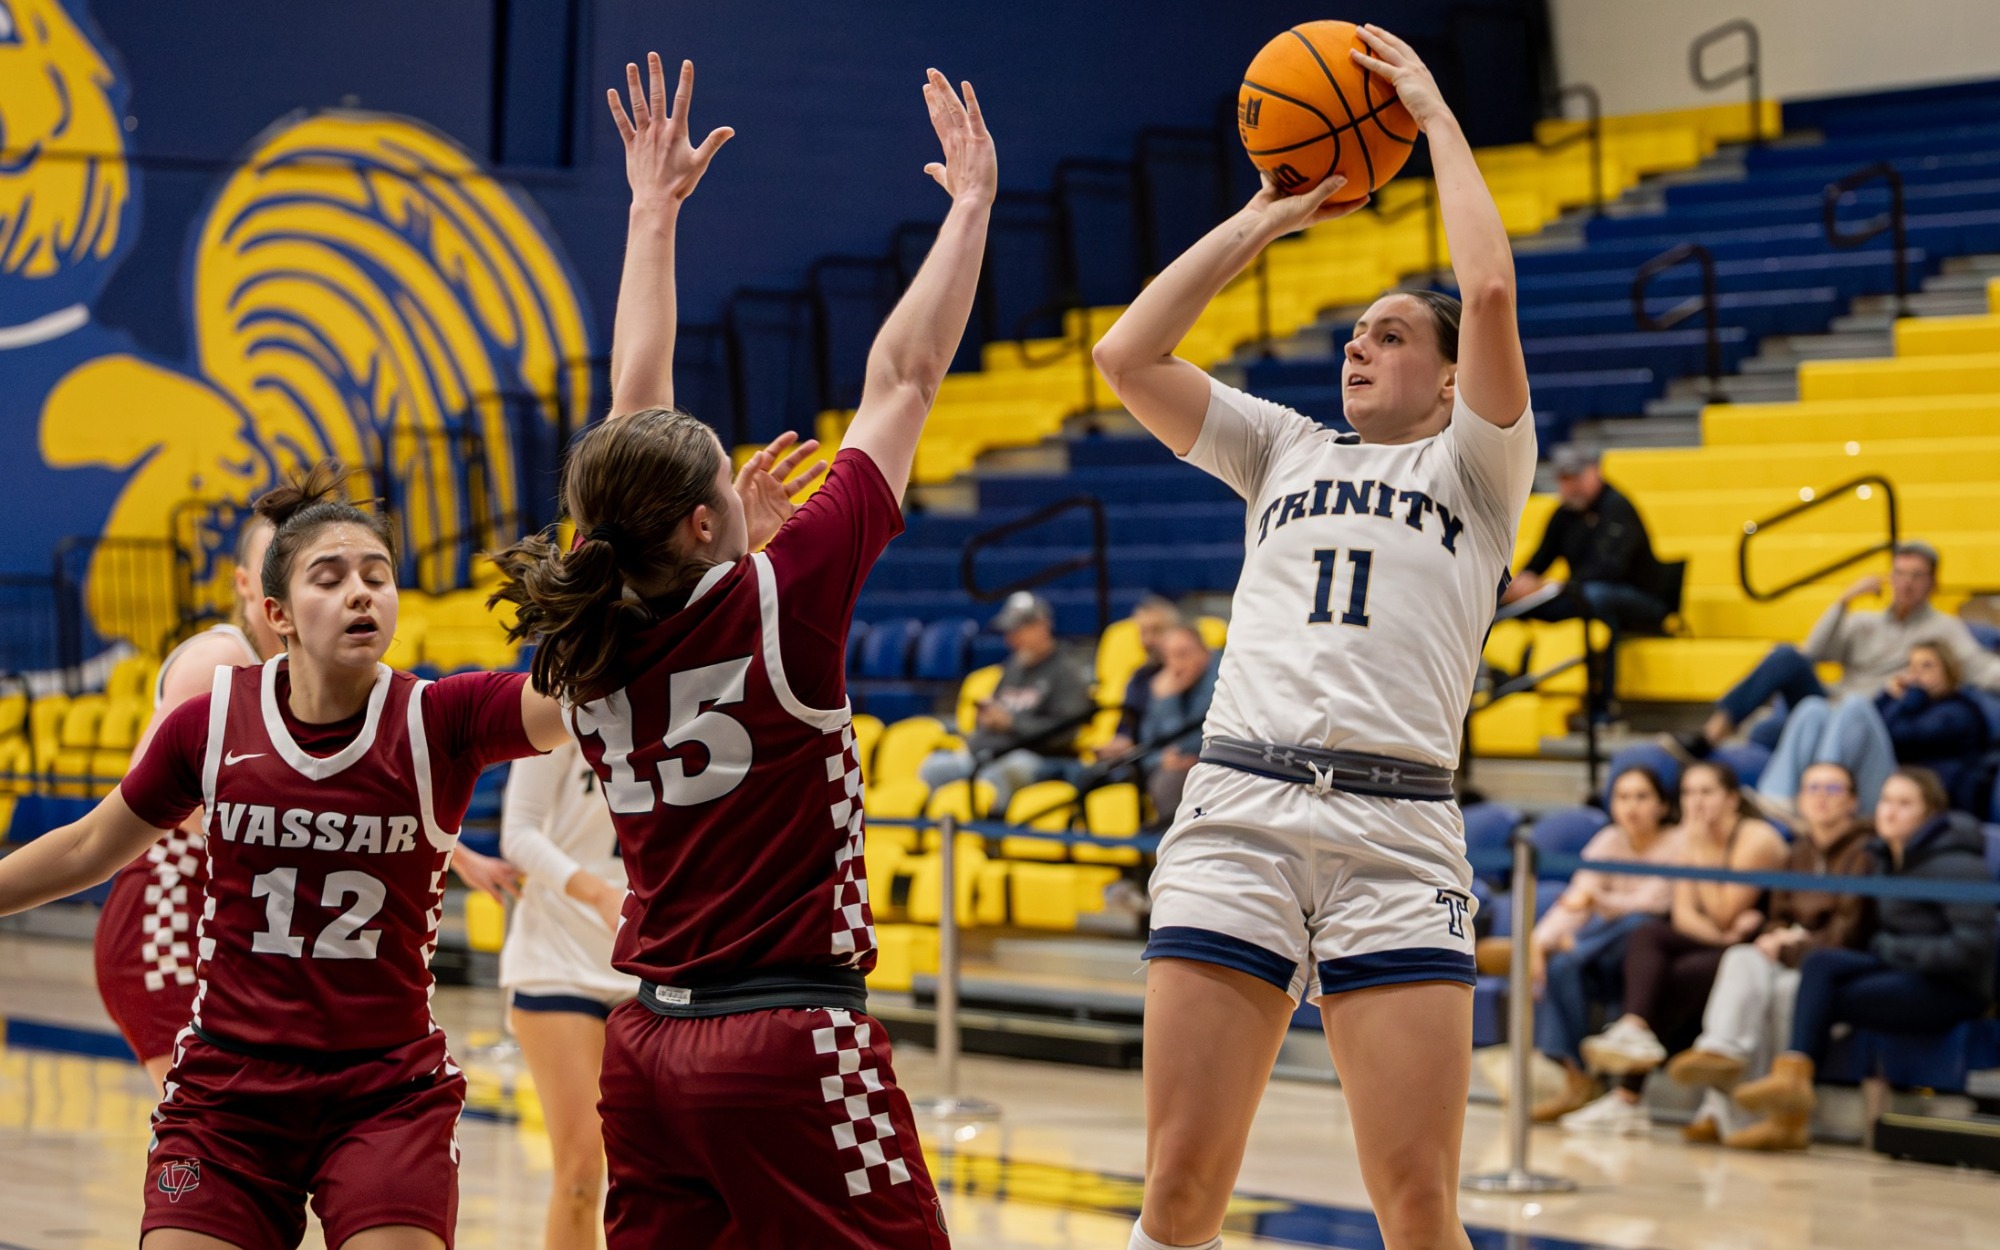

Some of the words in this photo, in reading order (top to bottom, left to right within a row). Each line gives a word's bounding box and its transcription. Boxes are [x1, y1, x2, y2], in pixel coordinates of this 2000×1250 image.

[1258, 479, 1464, 558] TRINITY
[1307, 547, 1374, 630] 11
[576, 655, 754, 814] 15
[216, 802, 419, 854] VASSAR
[251, 867, 387, 960] 12
[1435, 888, 1470, 940] T
